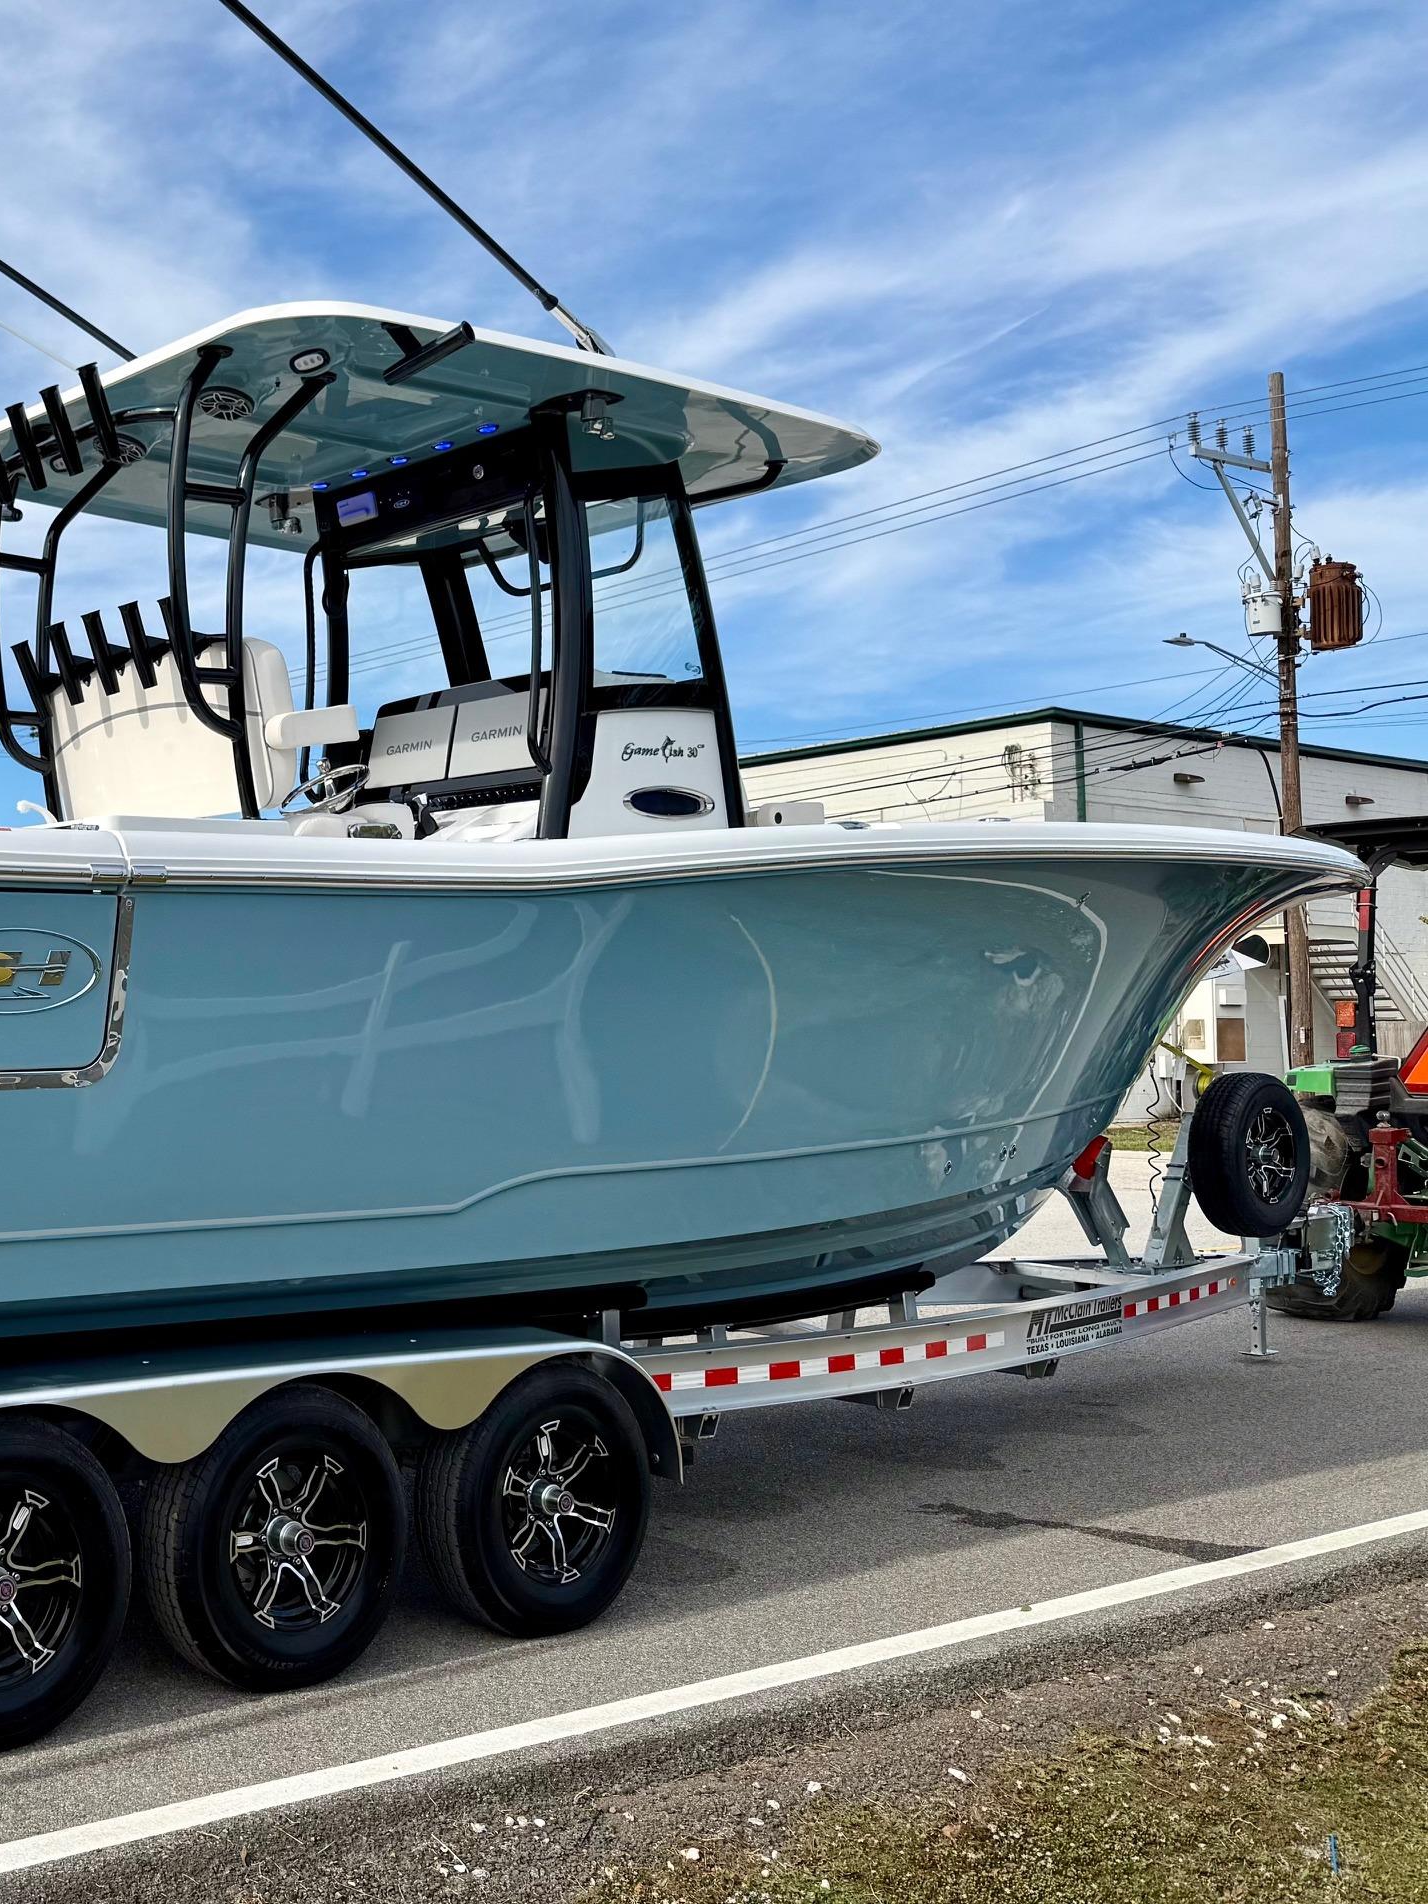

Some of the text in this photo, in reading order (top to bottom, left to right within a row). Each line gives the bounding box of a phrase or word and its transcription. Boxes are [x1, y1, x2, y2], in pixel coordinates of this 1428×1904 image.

[471, 724, 523, 742] GARMIN
[386, 739, 433, 756] GARMIN
[1054, 1296, 1122, 1321] McClain Trailers
[1078, 1324, 1100, 1334] LONG
[1026, 1326, 1122, 1355] TEXAS LOUISIANA ALABAMA
